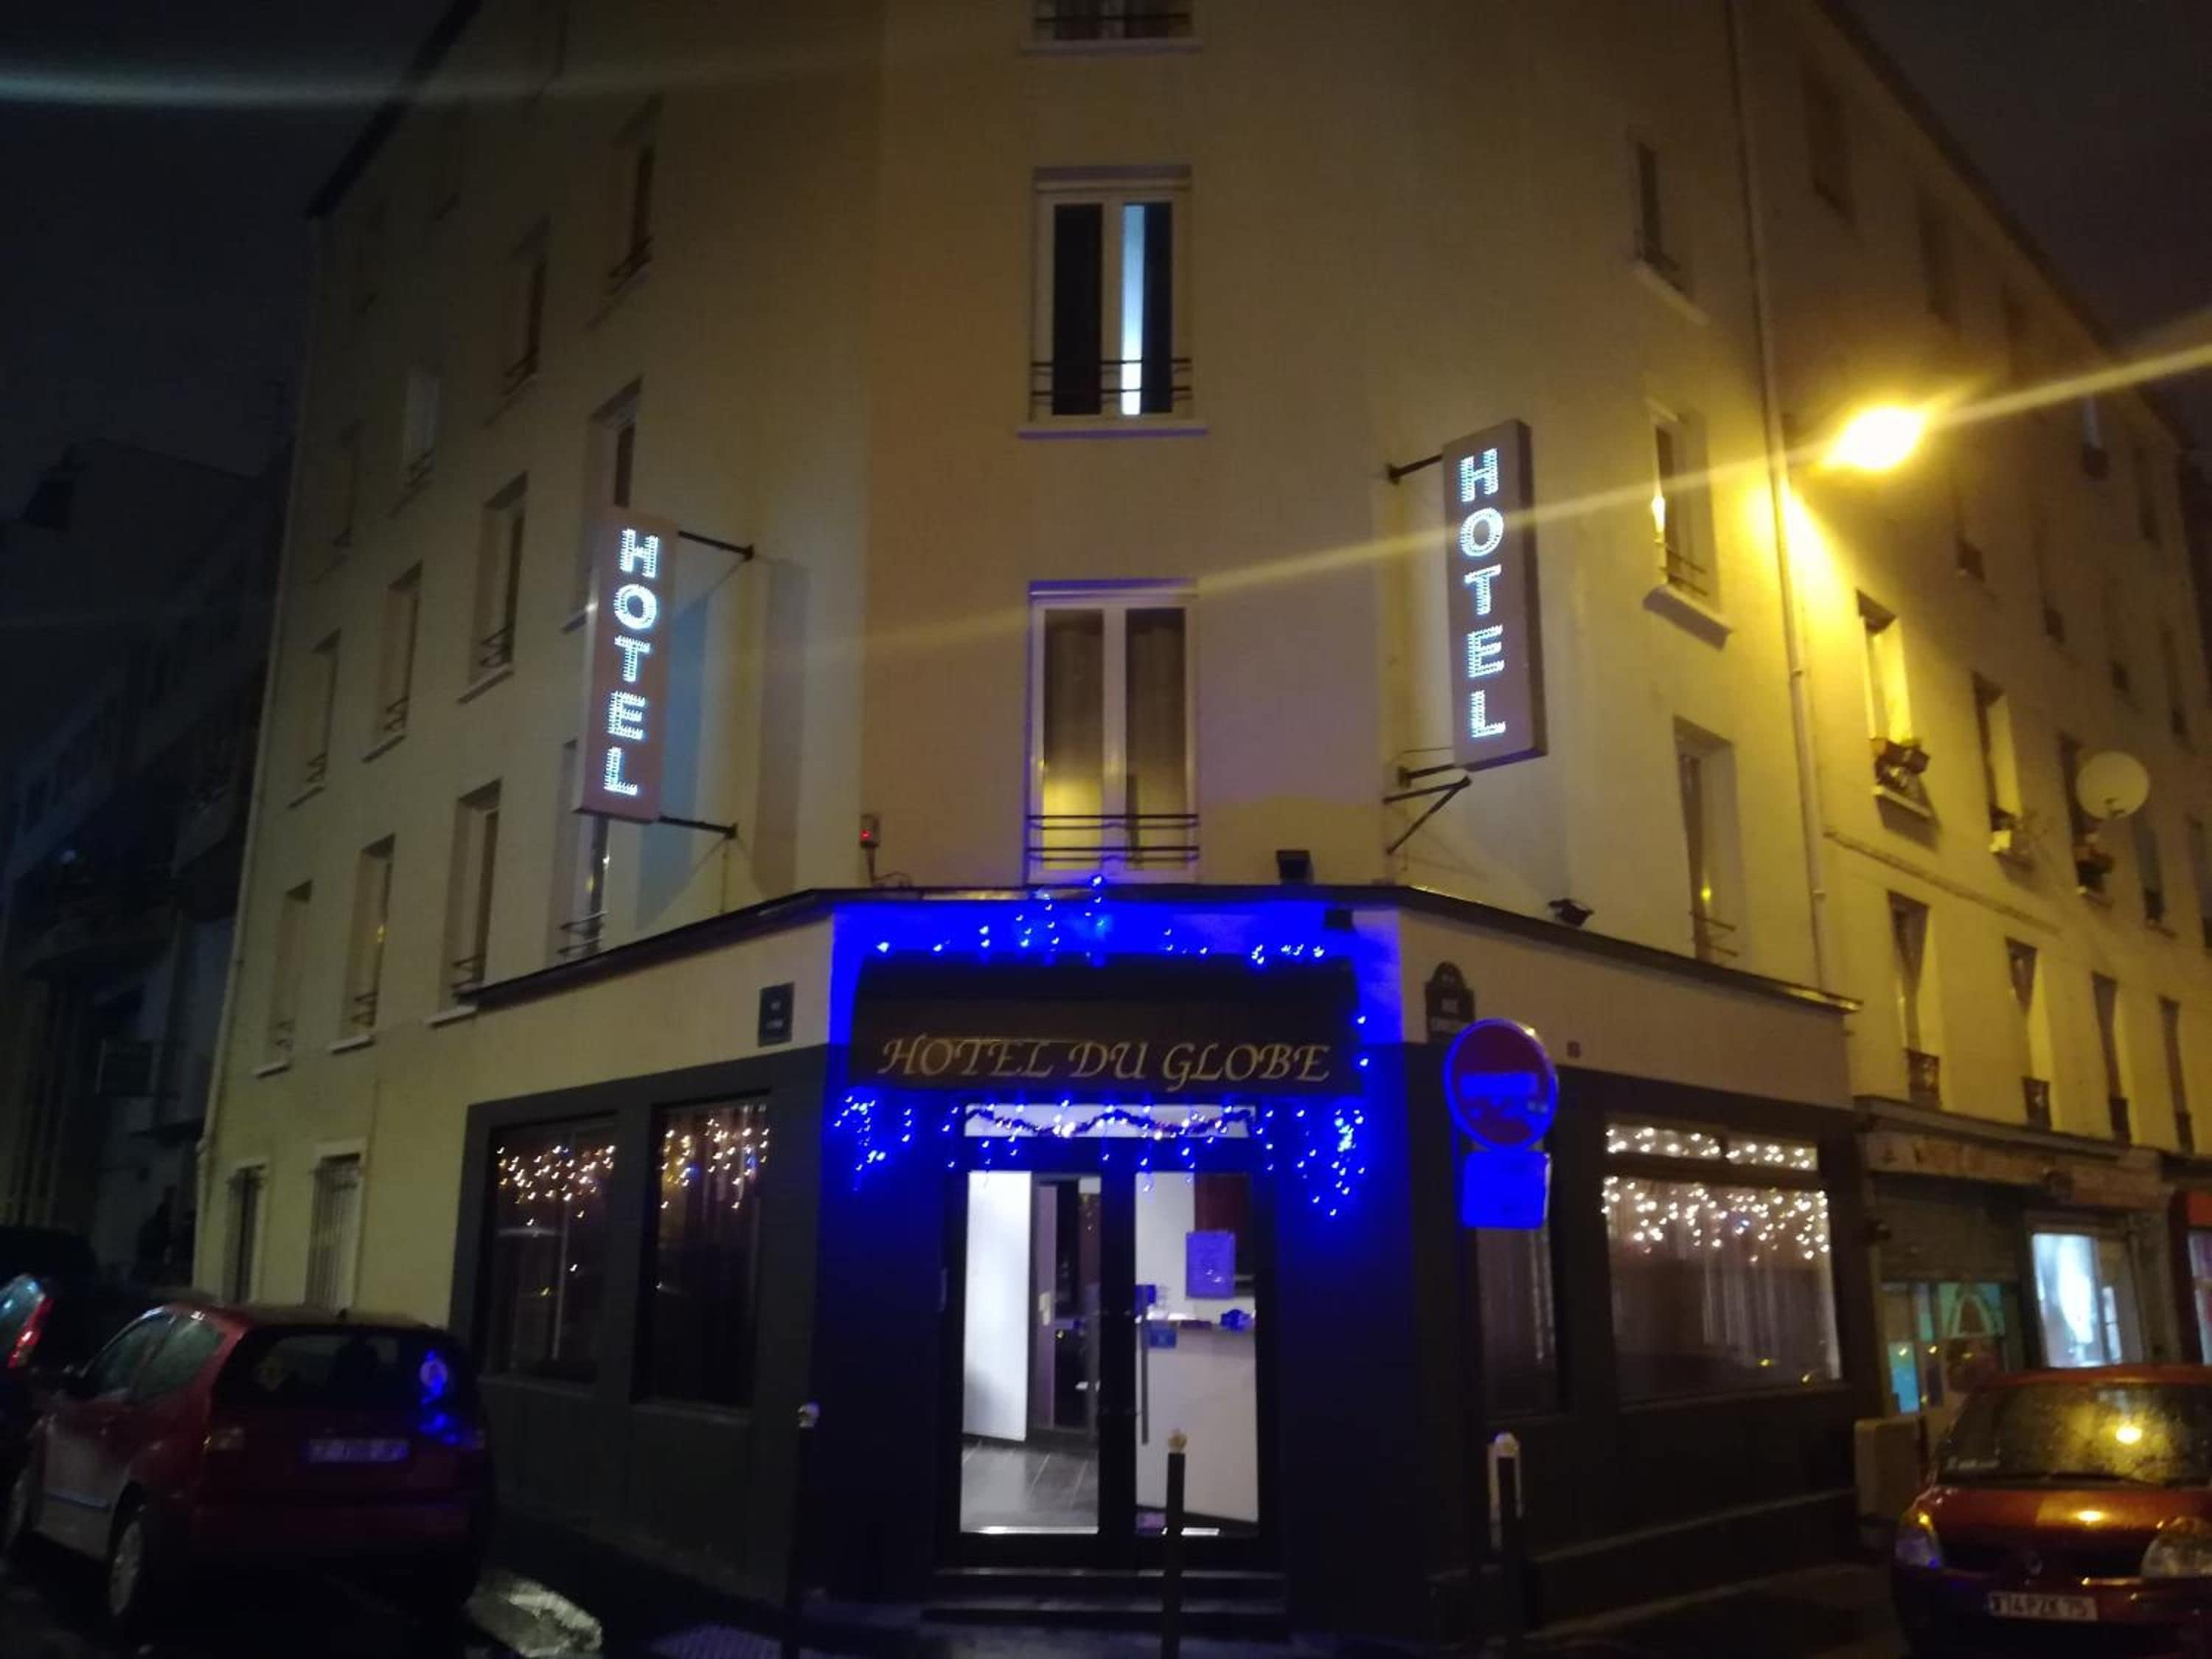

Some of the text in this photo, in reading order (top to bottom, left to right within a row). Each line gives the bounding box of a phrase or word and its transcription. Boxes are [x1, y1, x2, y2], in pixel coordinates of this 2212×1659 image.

[603, 527, 660, 796] HOTEL
[1458, 447, 1507, 739] HOTEL
[876, 1034, 1332, 1093] HOTEL DU GLOBE
